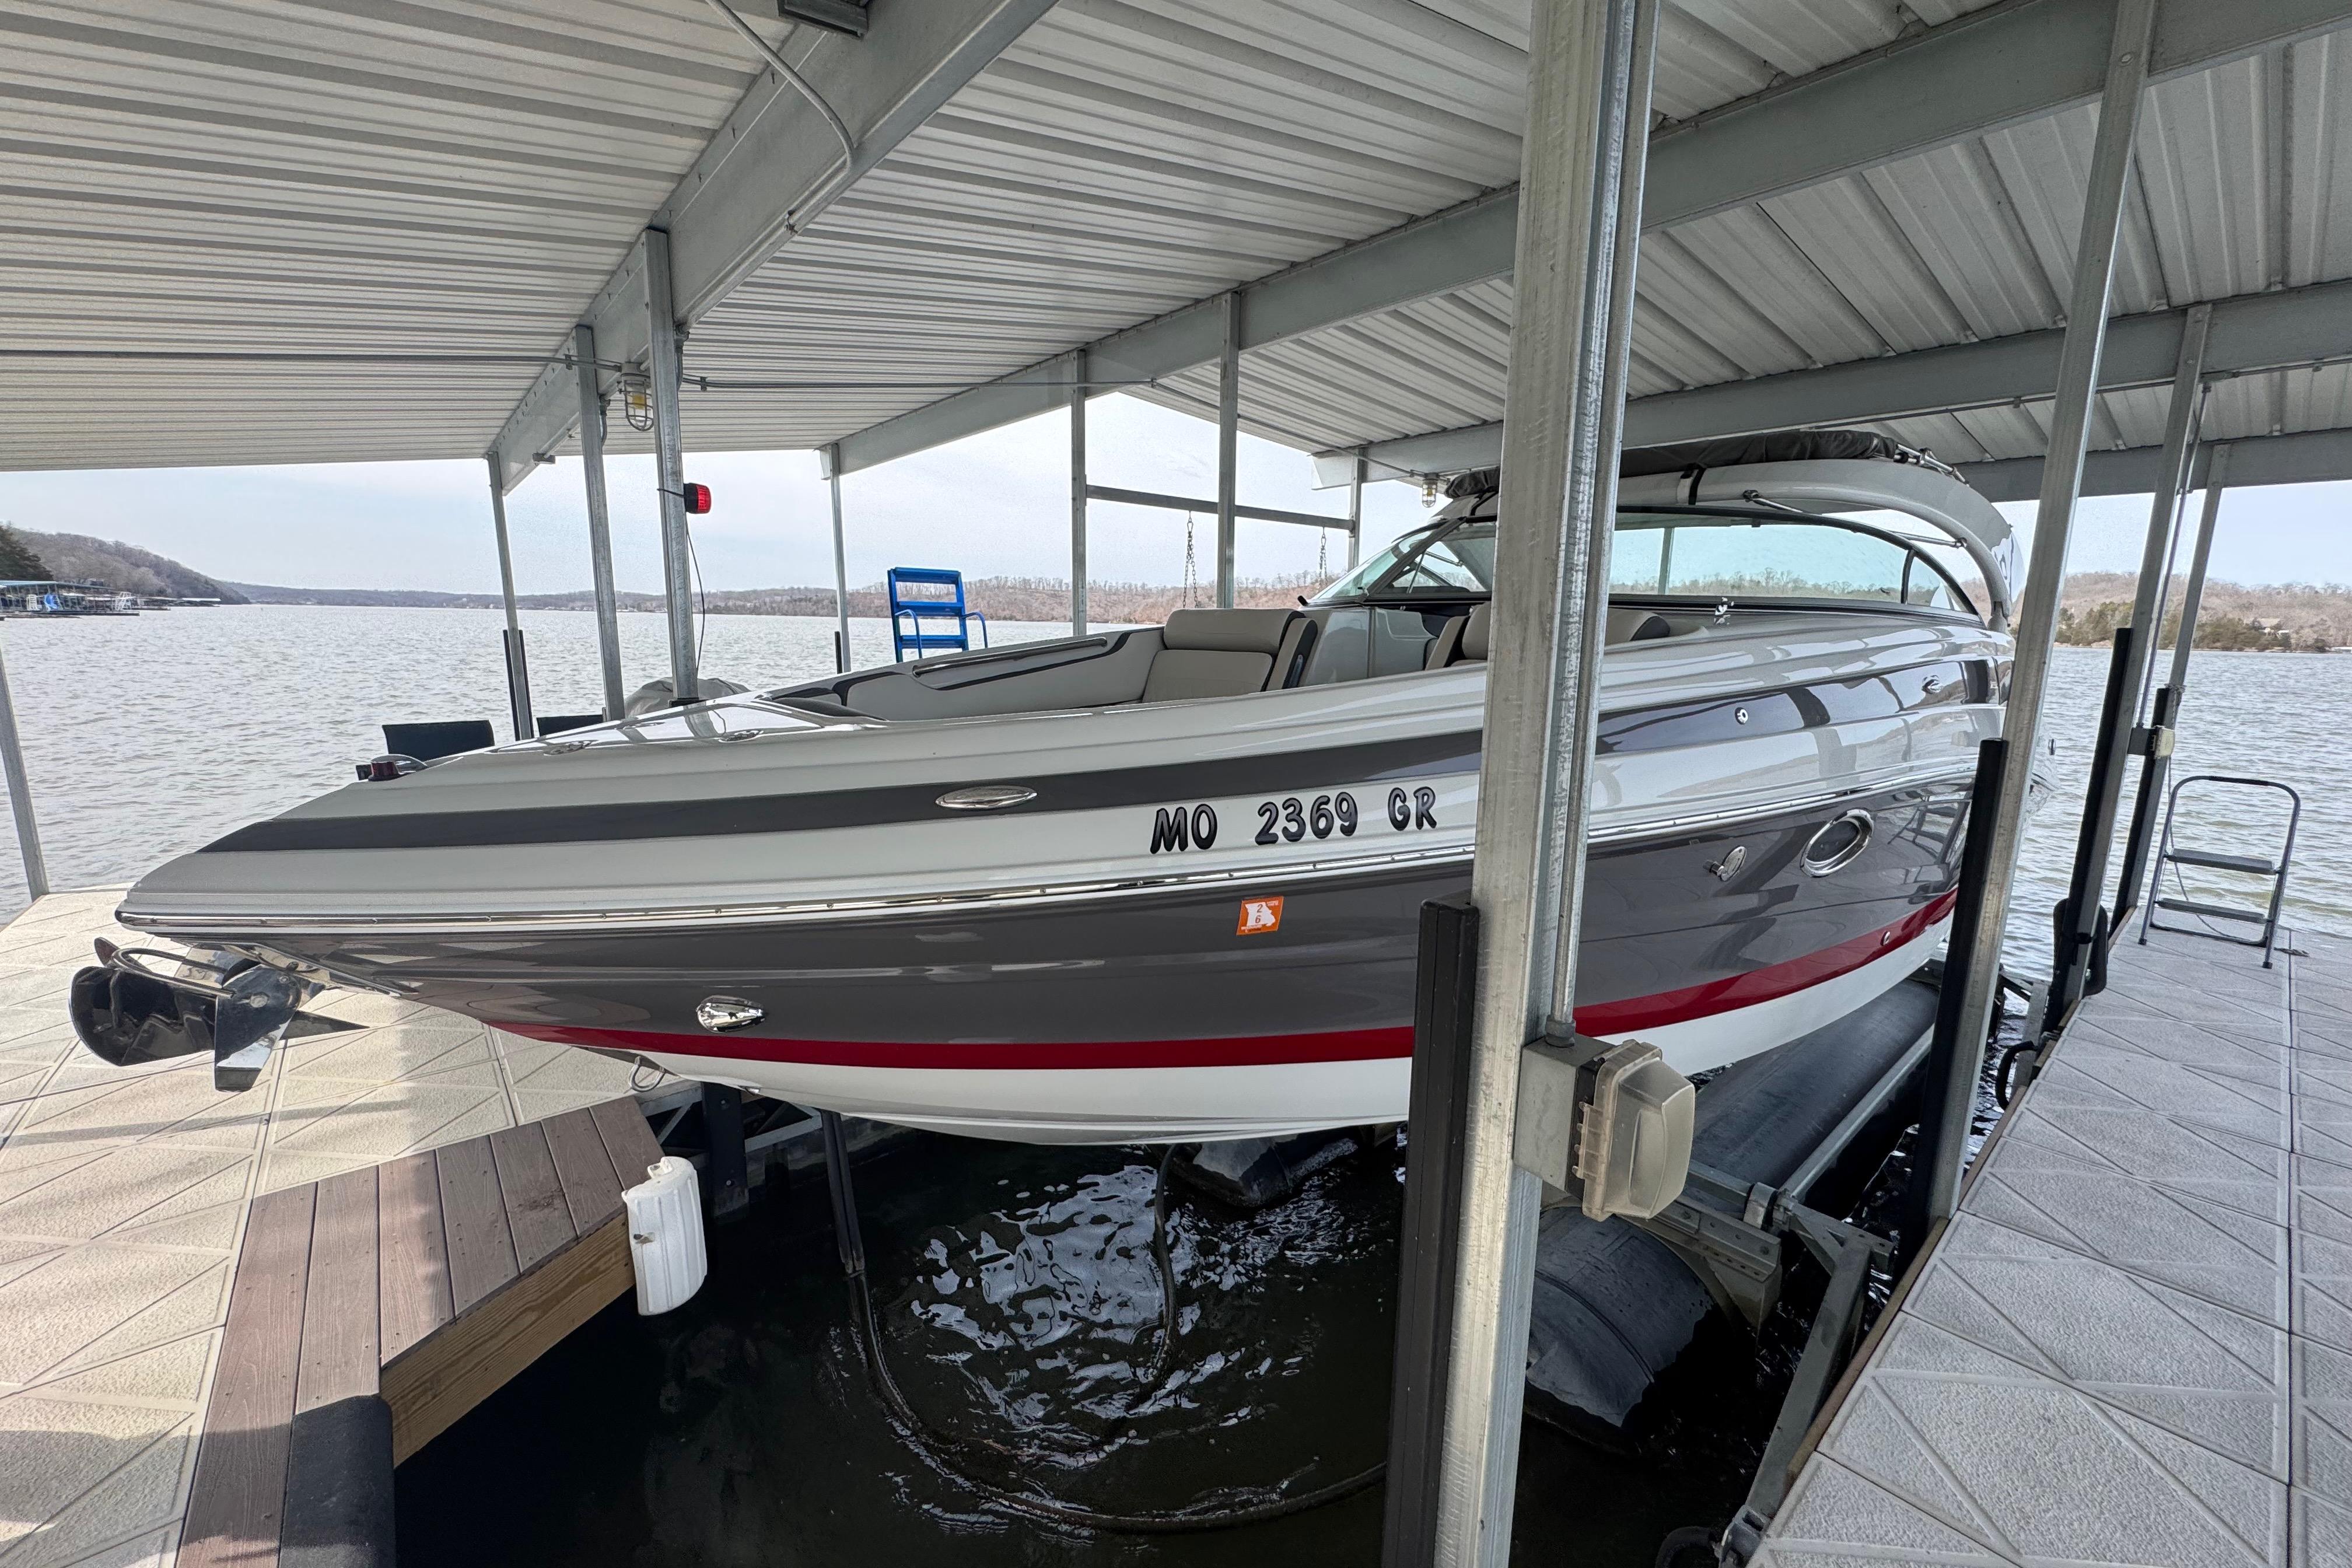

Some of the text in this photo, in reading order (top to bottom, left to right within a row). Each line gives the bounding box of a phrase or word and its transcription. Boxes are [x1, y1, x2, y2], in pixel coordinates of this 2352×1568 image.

[1150, 786, 1437, 855] MO 2369 GR
[1256, 904, 1263, 913] 2
[1255, 915, 1261, 923] 6
